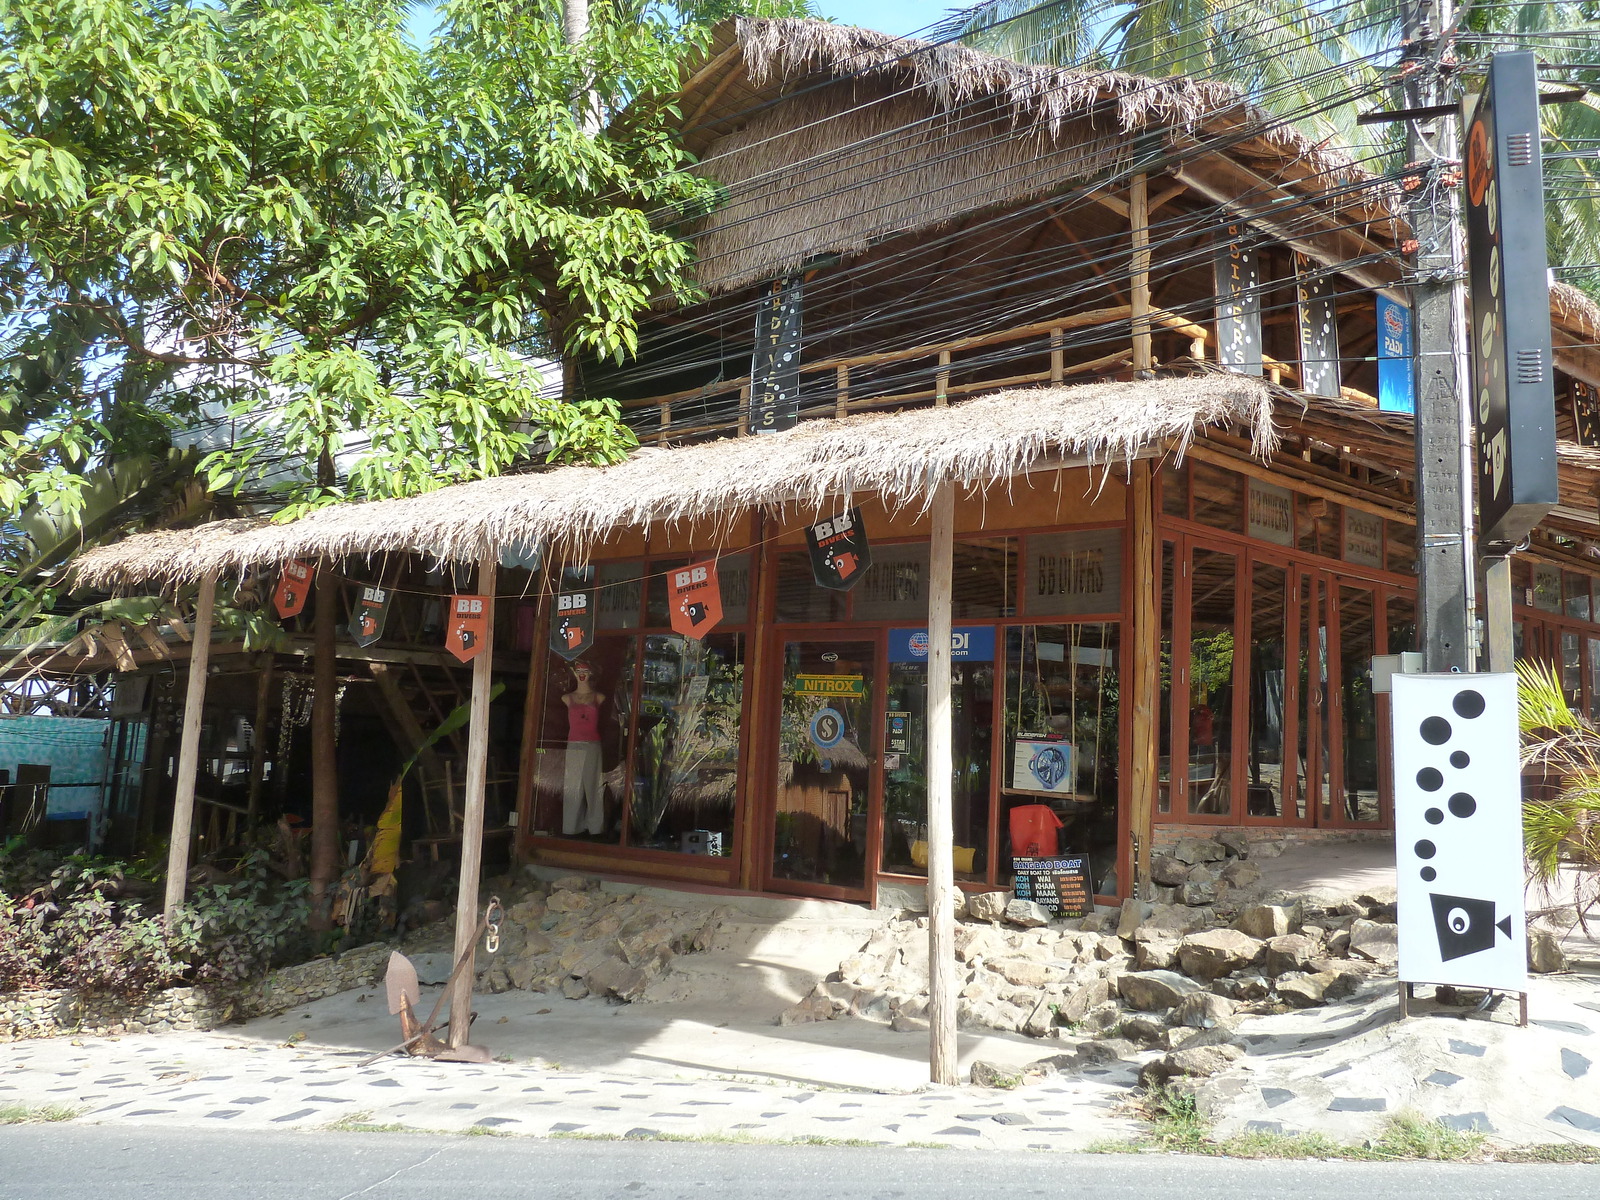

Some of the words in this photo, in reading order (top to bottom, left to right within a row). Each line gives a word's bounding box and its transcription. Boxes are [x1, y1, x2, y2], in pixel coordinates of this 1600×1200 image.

[1384, 336, 1403, 356] PADI
[814, 514, 853, 542] BB
[818, 529, 855, 548] DIVERS
[287, 561, 308, 579] BB
[675, 566, 708, 588] BB
[1058, 548, 1104, 595] DIVERS
[362, 587, 386, 603] BB
[677, 582, 708, 595] DIVERS
[456, 599, 483, 613] BB
[558, 594, 587, 611] BB
[558, 609, 587, 617] DIVERS
[803, 679, 855, 692] NITROX
[1053, 859, 1082, 870] BOAT
